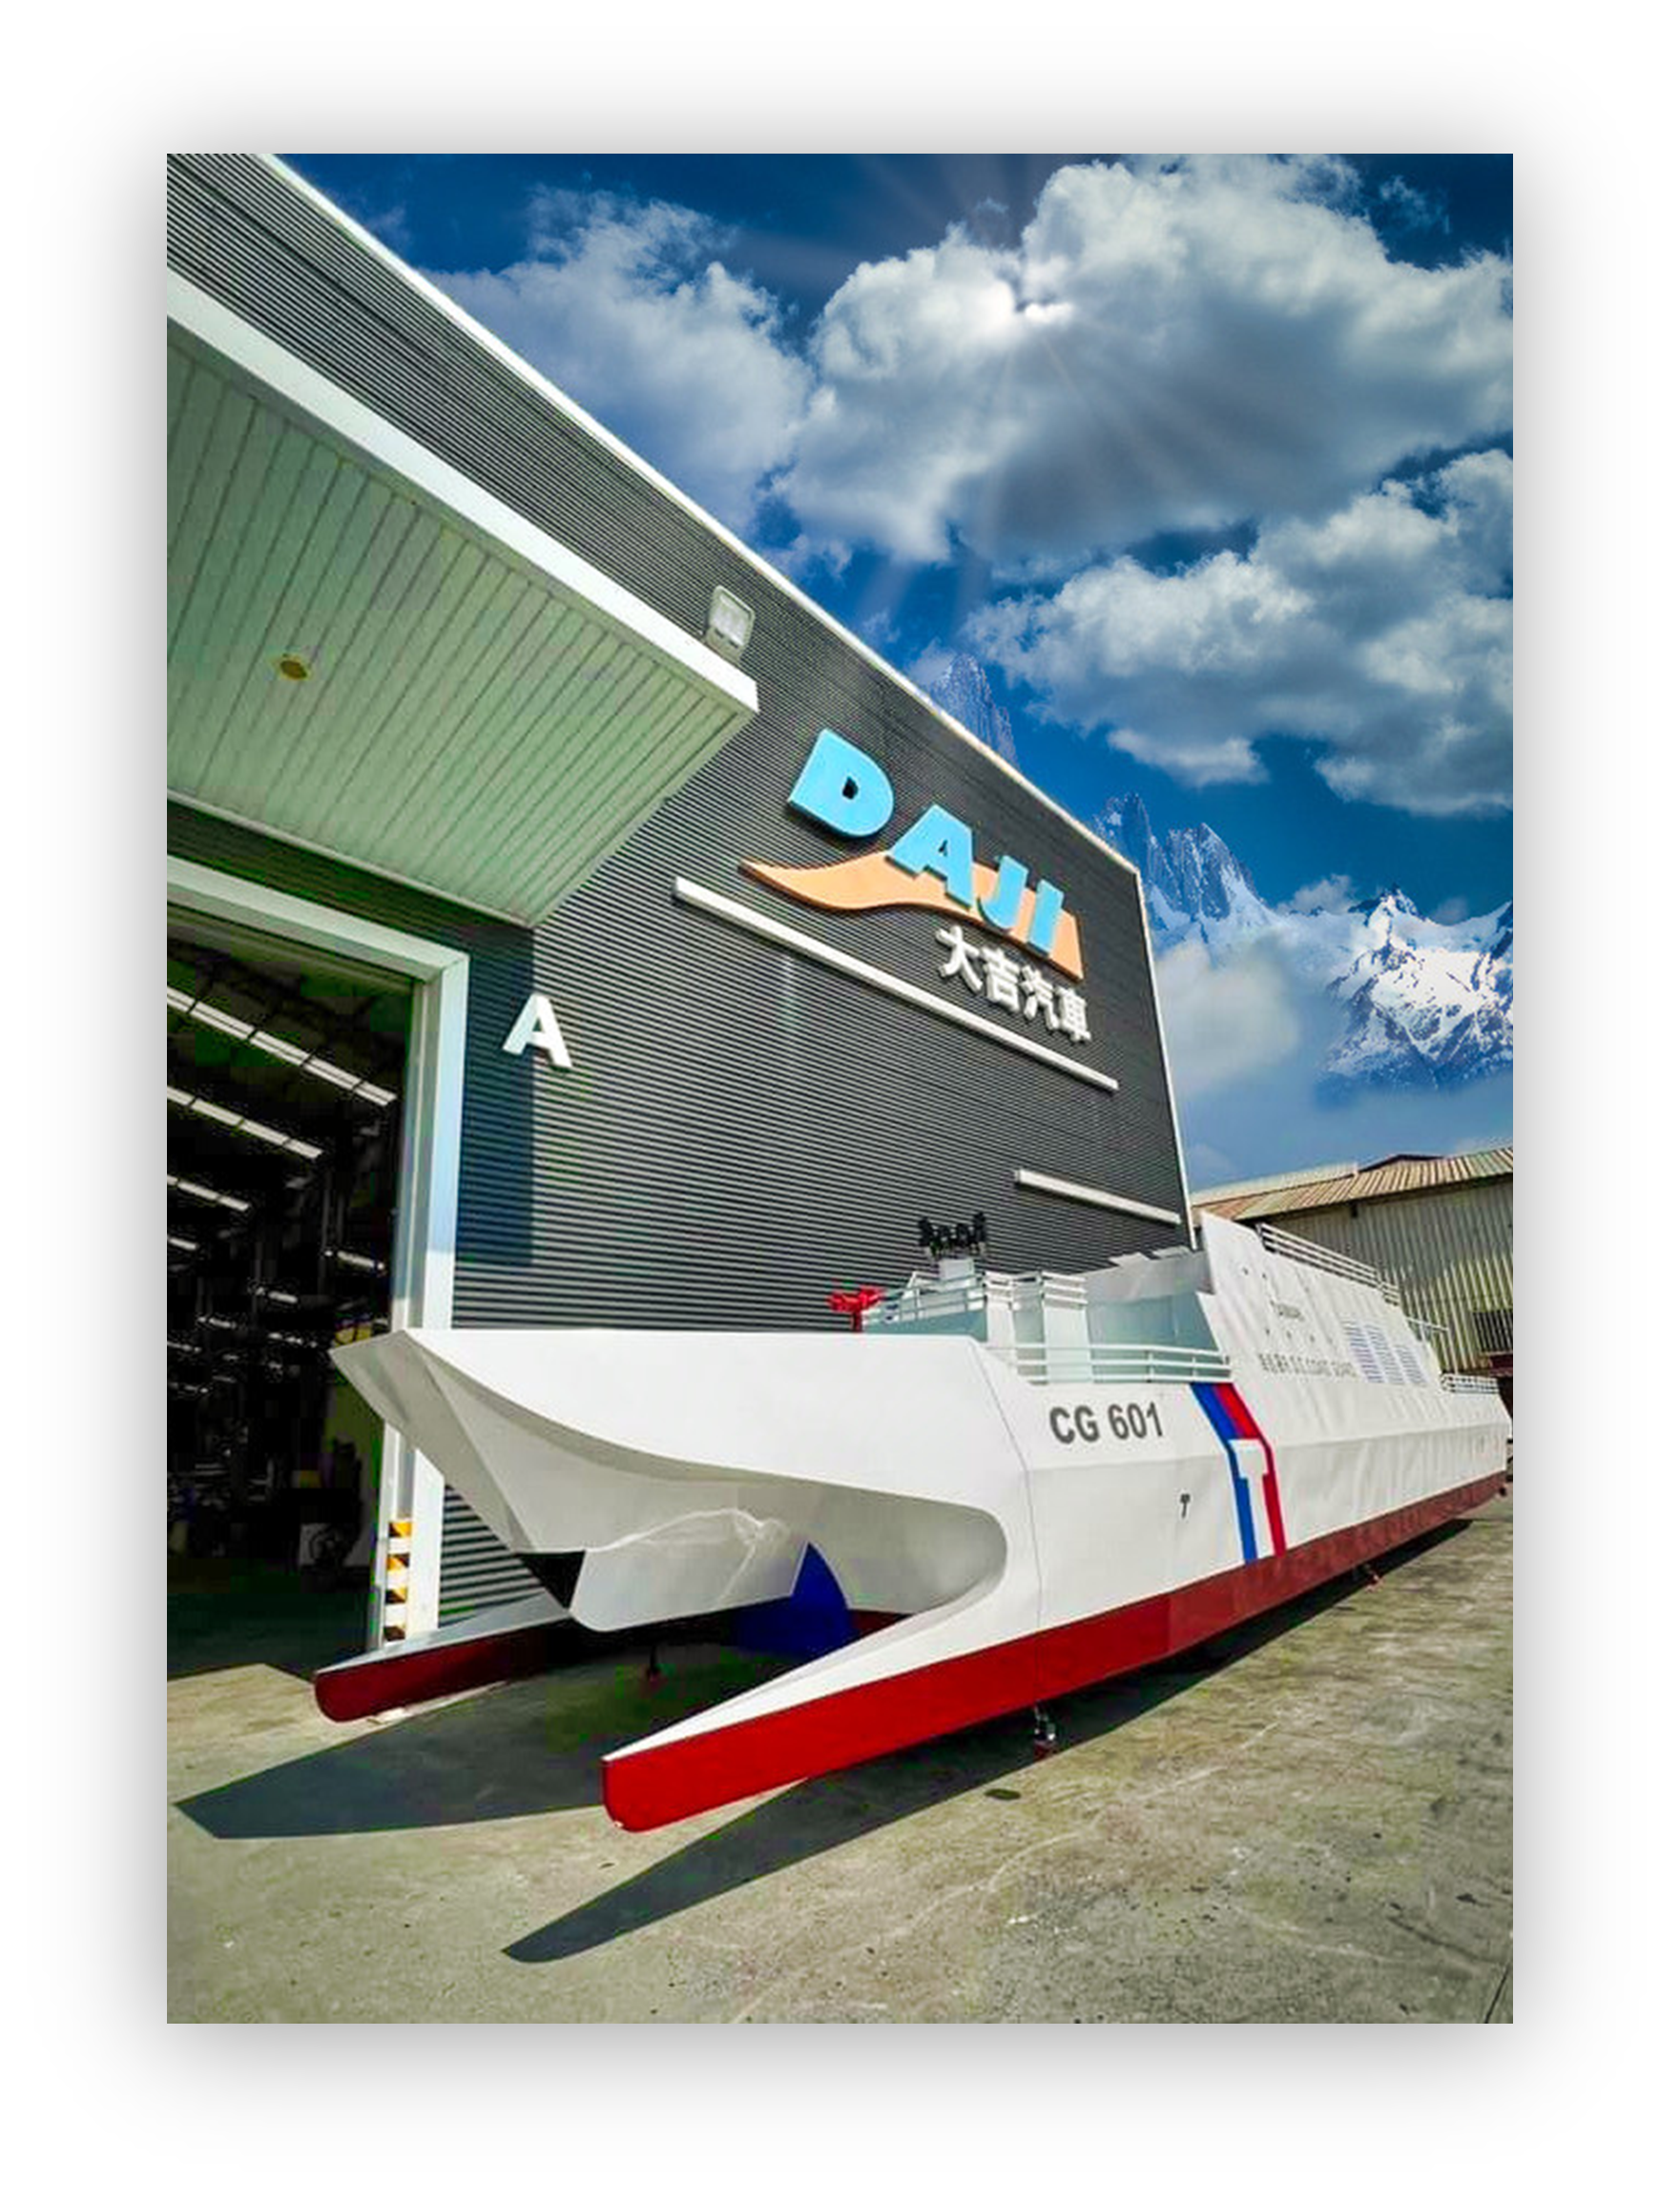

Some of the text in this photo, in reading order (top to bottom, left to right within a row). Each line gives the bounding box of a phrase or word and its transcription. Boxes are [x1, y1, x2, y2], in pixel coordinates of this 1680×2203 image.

[787, 728, 1065, 957] DAJI
[502, 992, 573, 1070] A
[935, 925, 1091, 1043] 大吉汽車
[1049, 1402, 1163, 1444] CG 601
